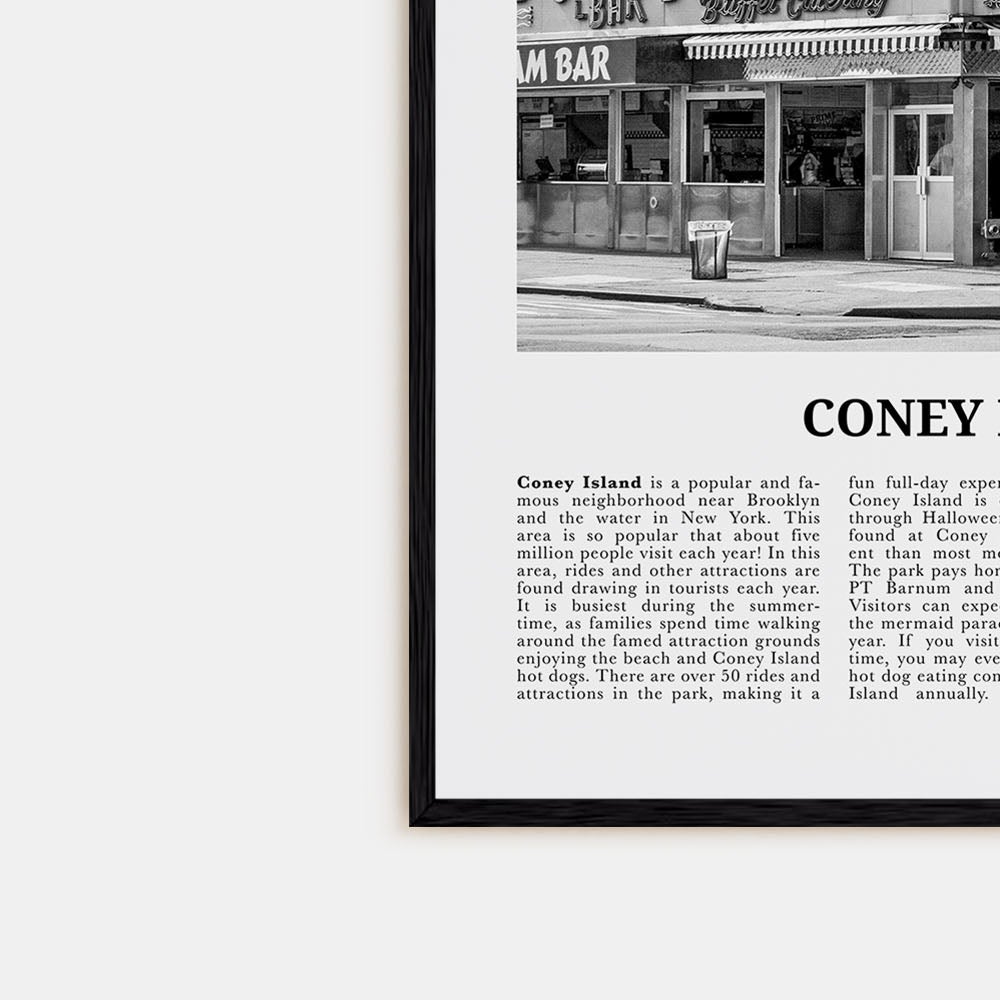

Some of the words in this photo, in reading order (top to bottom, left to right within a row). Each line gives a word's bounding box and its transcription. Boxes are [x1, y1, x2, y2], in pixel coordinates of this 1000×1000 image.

[554, 44, 612, 82] BAR
[803, 397, 984, 438] CONEY
[516, 475, 575, 493] Coney
[582, 475, 642, 490] Island
[650, 475, 663, 490] is
[671, 480, 680, 490] a
[688, 475, 753, 493] popular
[760, 475, 790, 490] and
[798, 475, 821, 490] fa-
[848, 475, 875, 490] fun
[886, 475, 949, 493] full-day
[516, 497, 559, 507] mous
[572, 493, 686, 511] neighborhood
[698, 497, 735, 507] near
[747, 493, 820, 511] Brooklyn
[848, 510, 913, 528] through
[516, 546, 574, 560] million
[580, 546, 634, 564] people
[639, 546, 673, 560] visit
[678, 546, 716, 560] each
[721, 546, 761, 564] year!
[768, 546, 785, 560] In
[791, 546, 821, 560] this
[848, 563, 881, 577] The
[888, 563, 925, 581] park
[931, 568, 967, 581] pays
[517, 598, 530, 613] It
[545, 598, 557, 613] is
[571, 598, 627, 613] busiest
[641, 598, 696, 616] during
[710, 598, 735, 613] the
[749, 603, 820, 613] summer-
[849, 616, 874, 630] the
[881, 616, 954, 630] mermaid
[516, 651, 587, 669] enjoying
[592, 651, 617, 665] the
[623, 651, 670, 665] beach
[676, 651, 707, 665] and
[712, 651, 765, 669] Coney
[770, 651, 820, 665] Island
[848, 669, 875, 683] hot
[881, 669, 912, 687] dog
[917, 669, 968, 687] eating
